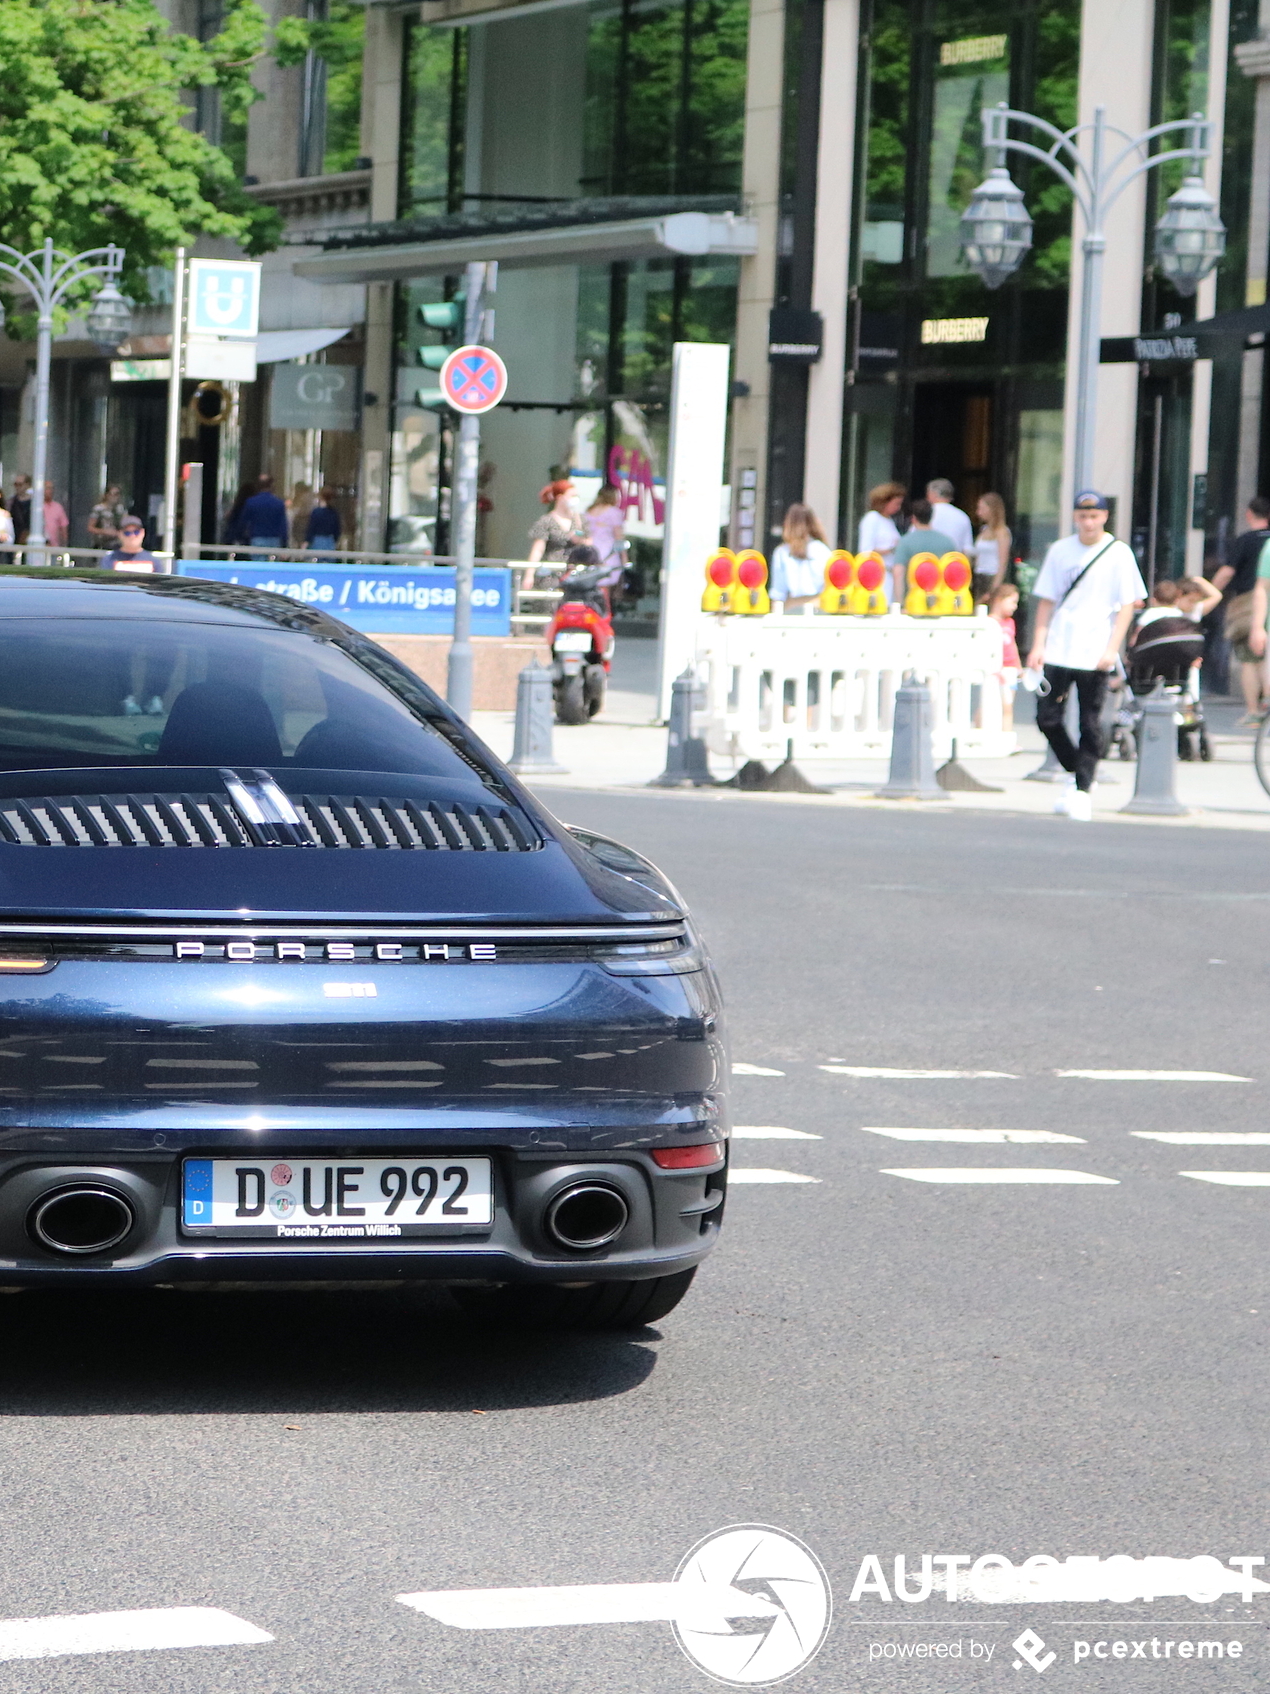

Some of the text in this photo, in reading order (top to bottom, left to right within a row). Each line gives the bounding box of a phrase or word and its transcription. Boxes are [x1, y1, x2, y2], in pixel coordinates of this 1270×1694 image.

[940, 34, 1007, 66] BURBERRY
[205, 276, 245, 325] U
[921, 317, 989, 344] BURBERRY
[771, 343, 819, 355] BURBERRY
[340, 580, 353, 605] /
[358, 579, 500, 610] Königsaee
[176, 941, 496, 960] PORSCHE
[235, 1166, 469, 1217] D UE 992
[193, 1201, 204, 1214] D
[277, 1224, 402, 1237] Porsche Zentrum Willich
